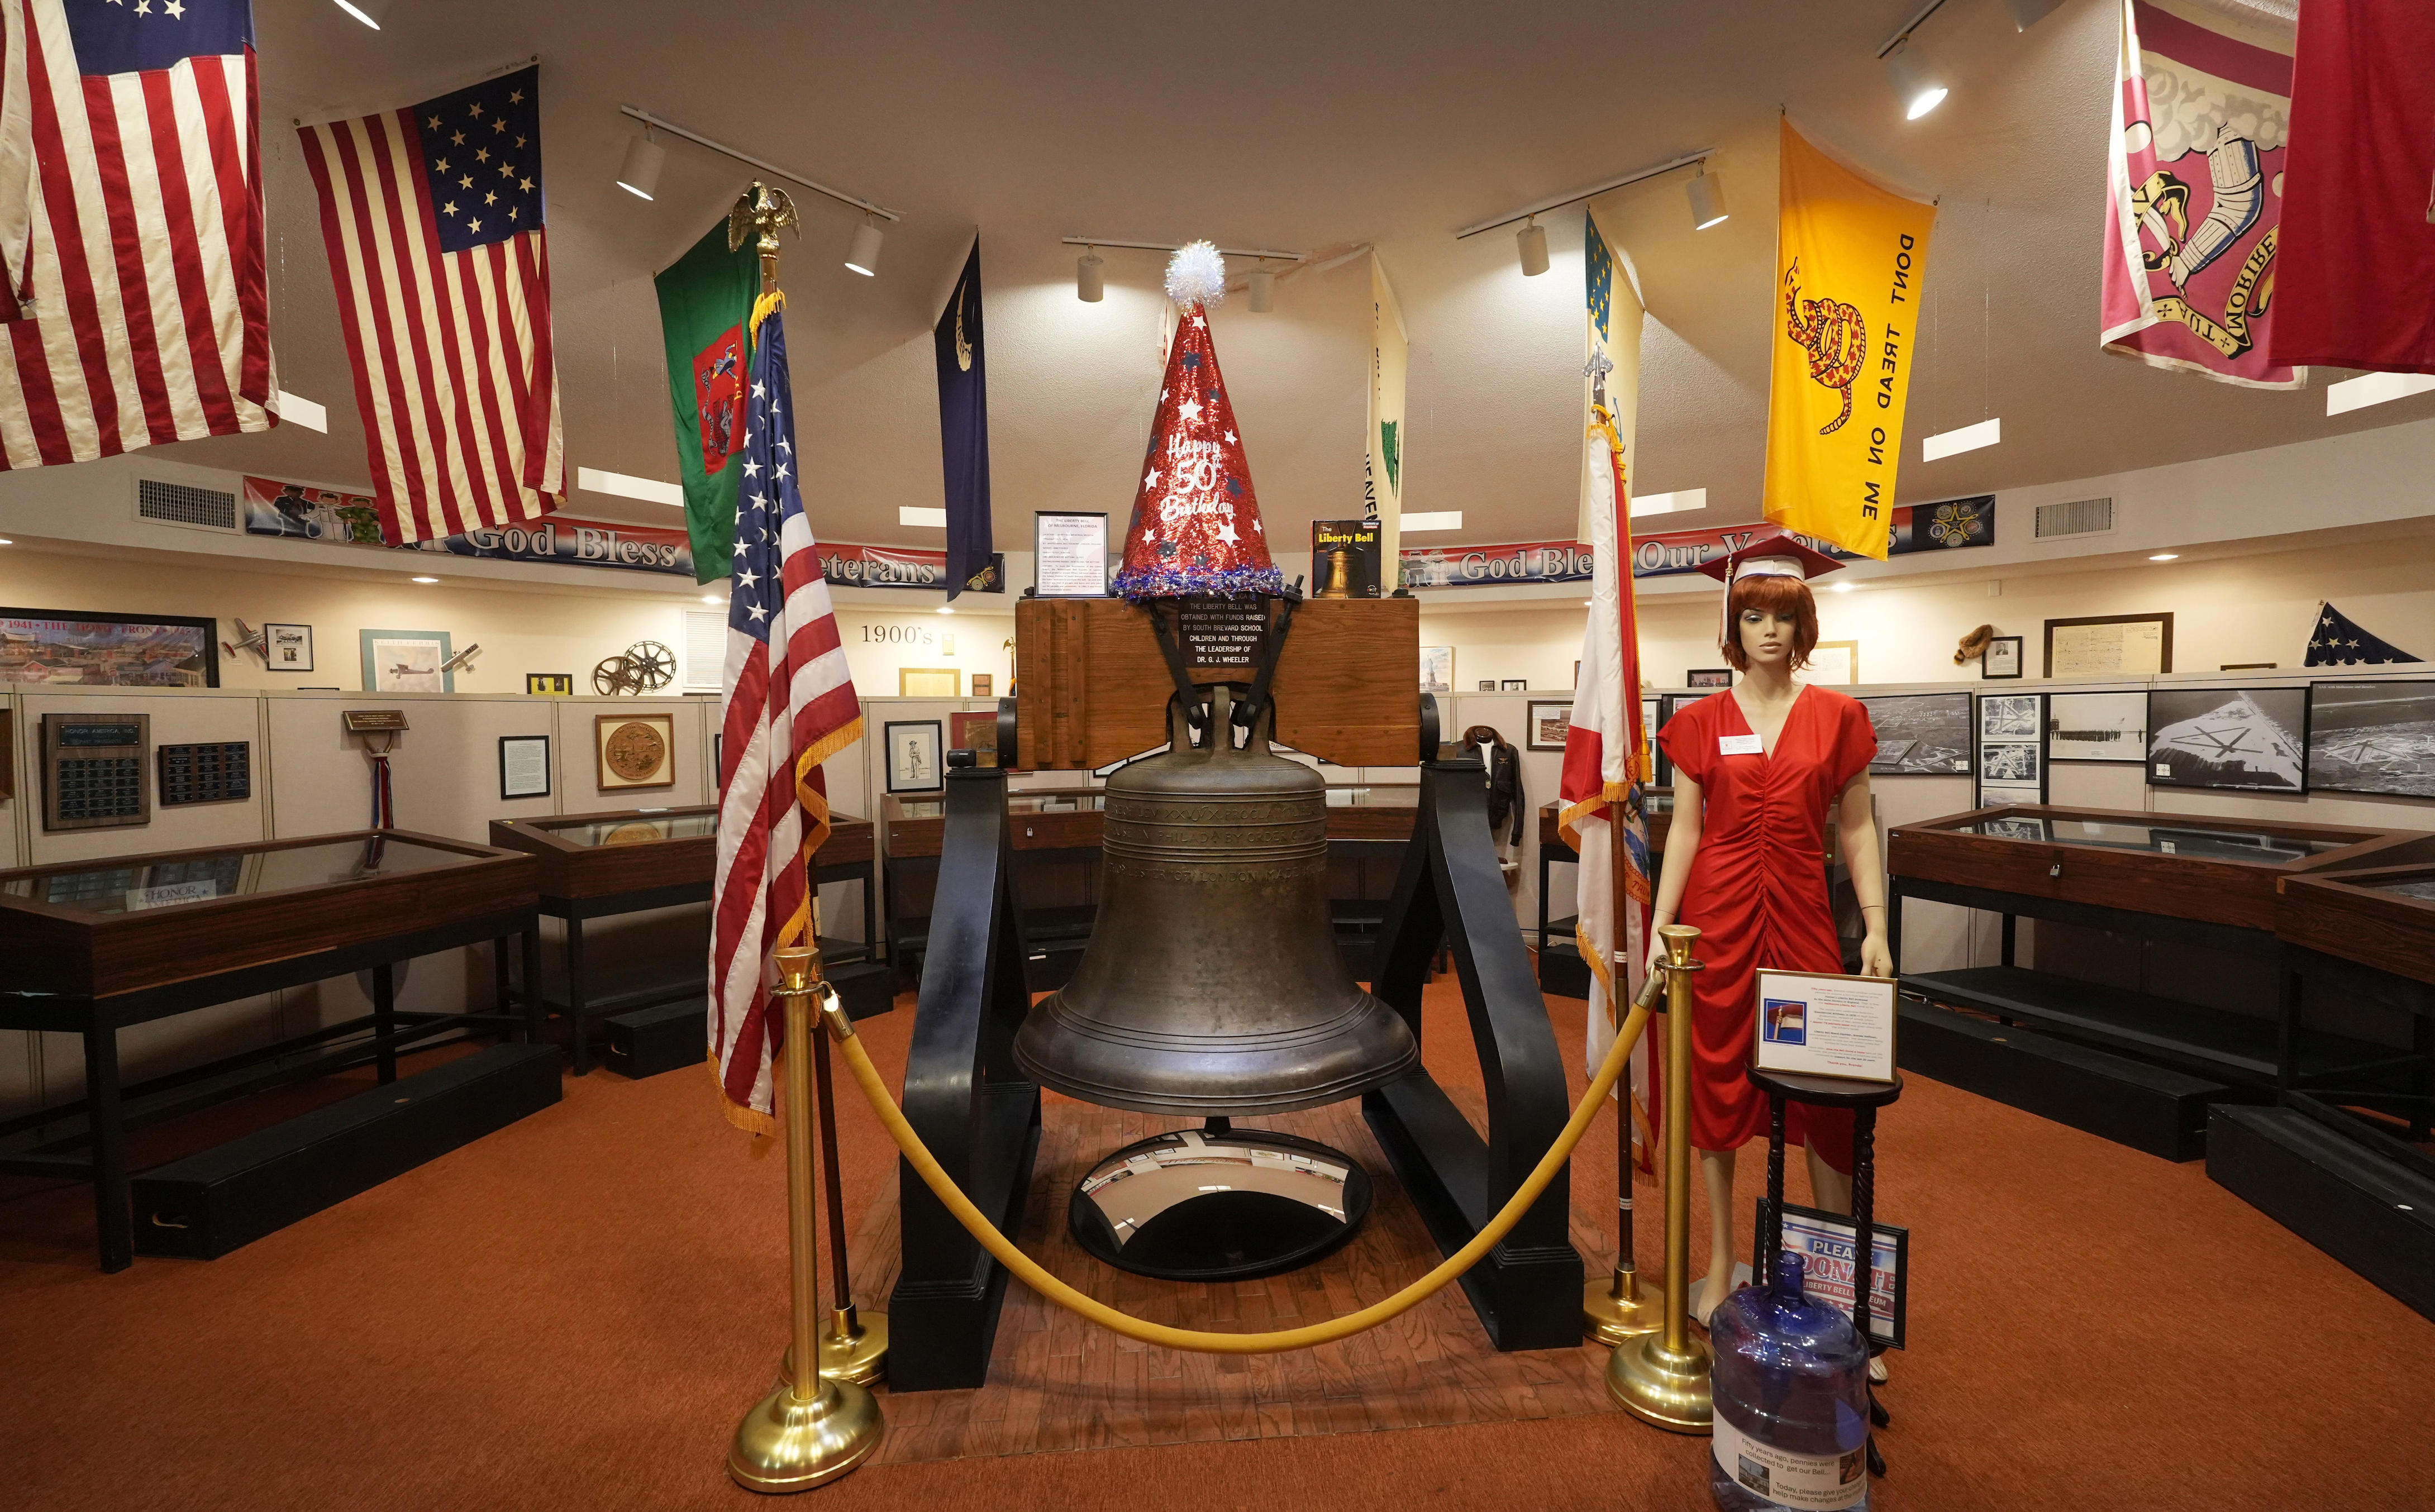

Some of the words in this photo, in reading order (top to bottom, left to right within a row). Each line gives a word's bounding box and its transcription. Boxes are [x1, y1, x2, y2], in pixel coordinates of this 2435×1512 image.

[1166, 432, 1222, 463] Happy
[1160, 491, 1236, 522] Birthday
[463, 522, 557, 557] God
[571, 525, 676, 567] Bless
[1318, 533, 1353, 544] Liberty
[1355, 532, 1374, 542] Bell
[817, 552, 935, 584] eterans
[1459, 550, 1528, 580] God
[1539, 547, 1594, 576] Ble
[1636, 541, 1710, 571] Our
[8, 619, 32, 629] 1941
[43, 622, 70, 631] THE
[861, 624, 932, 645] 1900's
[1200, 871, 1257, 882] LONDON
[151, 885, 196, 900] HONOR
[1813, 1239, 1855, 1260] PLEA
[1798, 1251, 1895, 1293] DONTE
[1833, 1286, 1851, 1297] BELL
[1742, 1438, 1755, 1451] Fifty
[1755, 1446, 1774, 1457] years
[1775, 1454, 1789, 1462] ago,
[1790, 1458, 1818, 1467] pennies
[1745, 1449, 1775, 1466] collected
[1772, 1488, 1788, 1499] help
[1775, 1481, 1798, 1494] Today,
